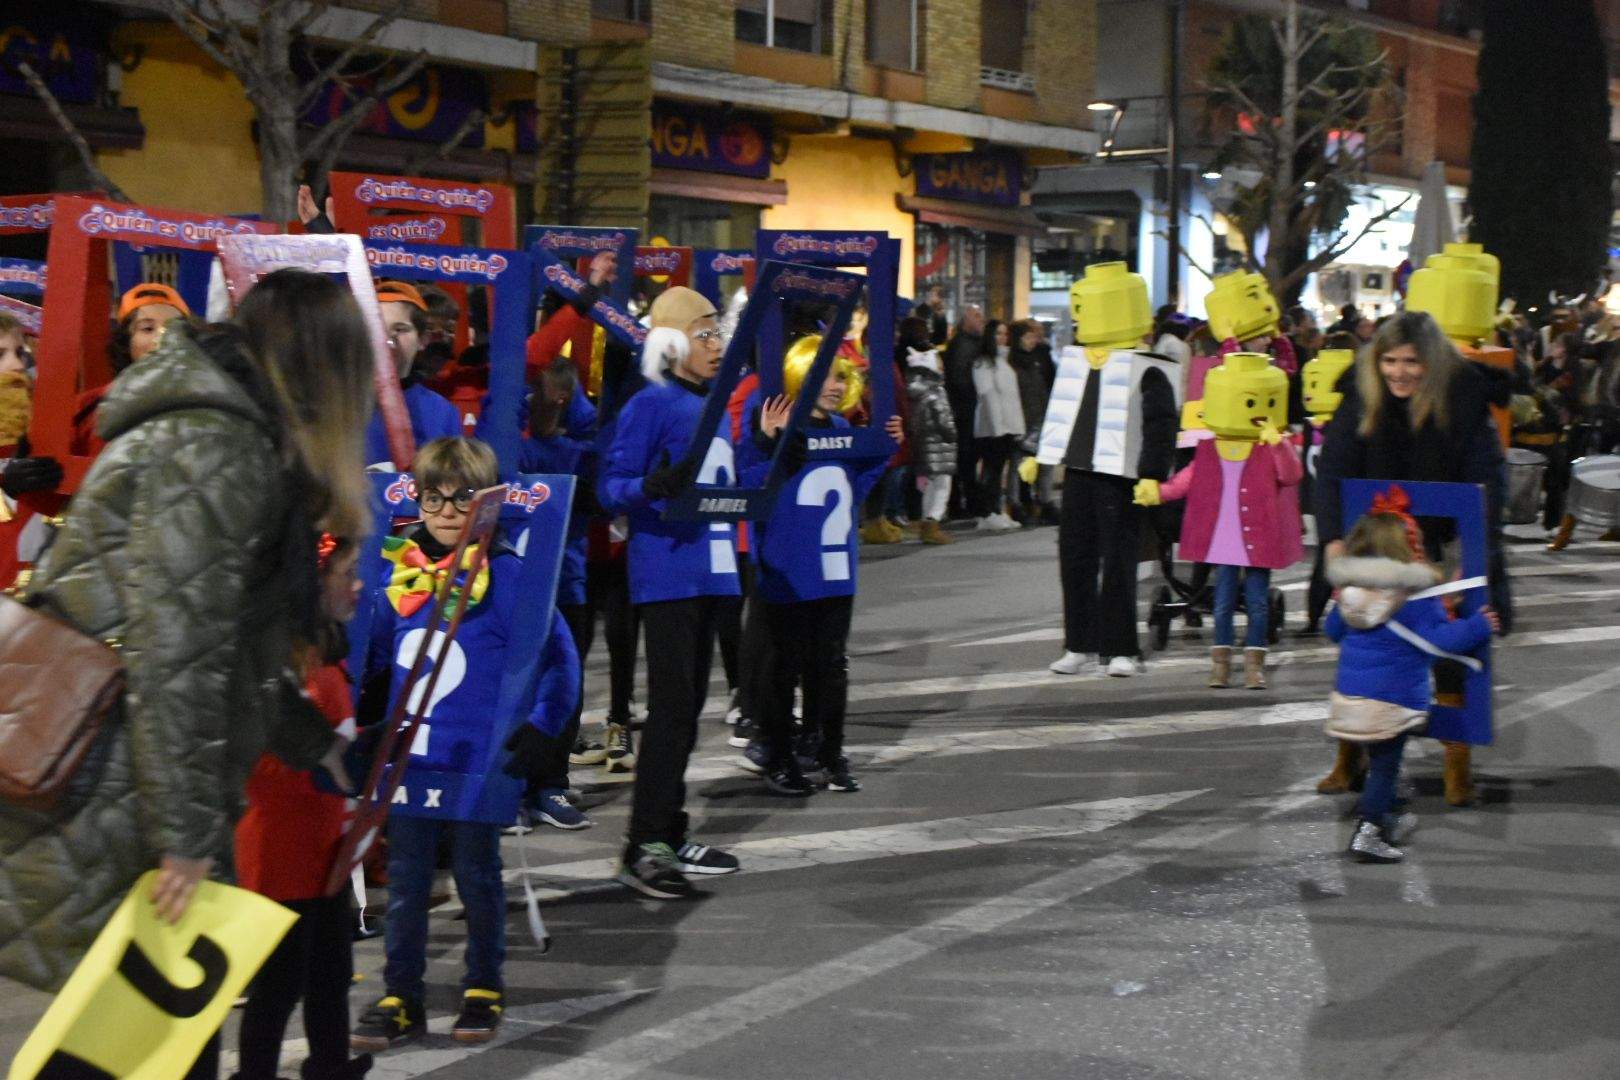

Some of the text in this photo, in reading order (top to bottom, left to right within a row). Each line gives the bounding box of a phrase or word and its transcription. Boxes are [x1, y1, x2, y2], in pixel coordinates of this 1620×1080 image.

[651, 116, 709, 159] NGA
[929, 155, 1009, 194] GANGA
[417, 254, 437, 271] es
[808, 436, 854, 451] DAISY
